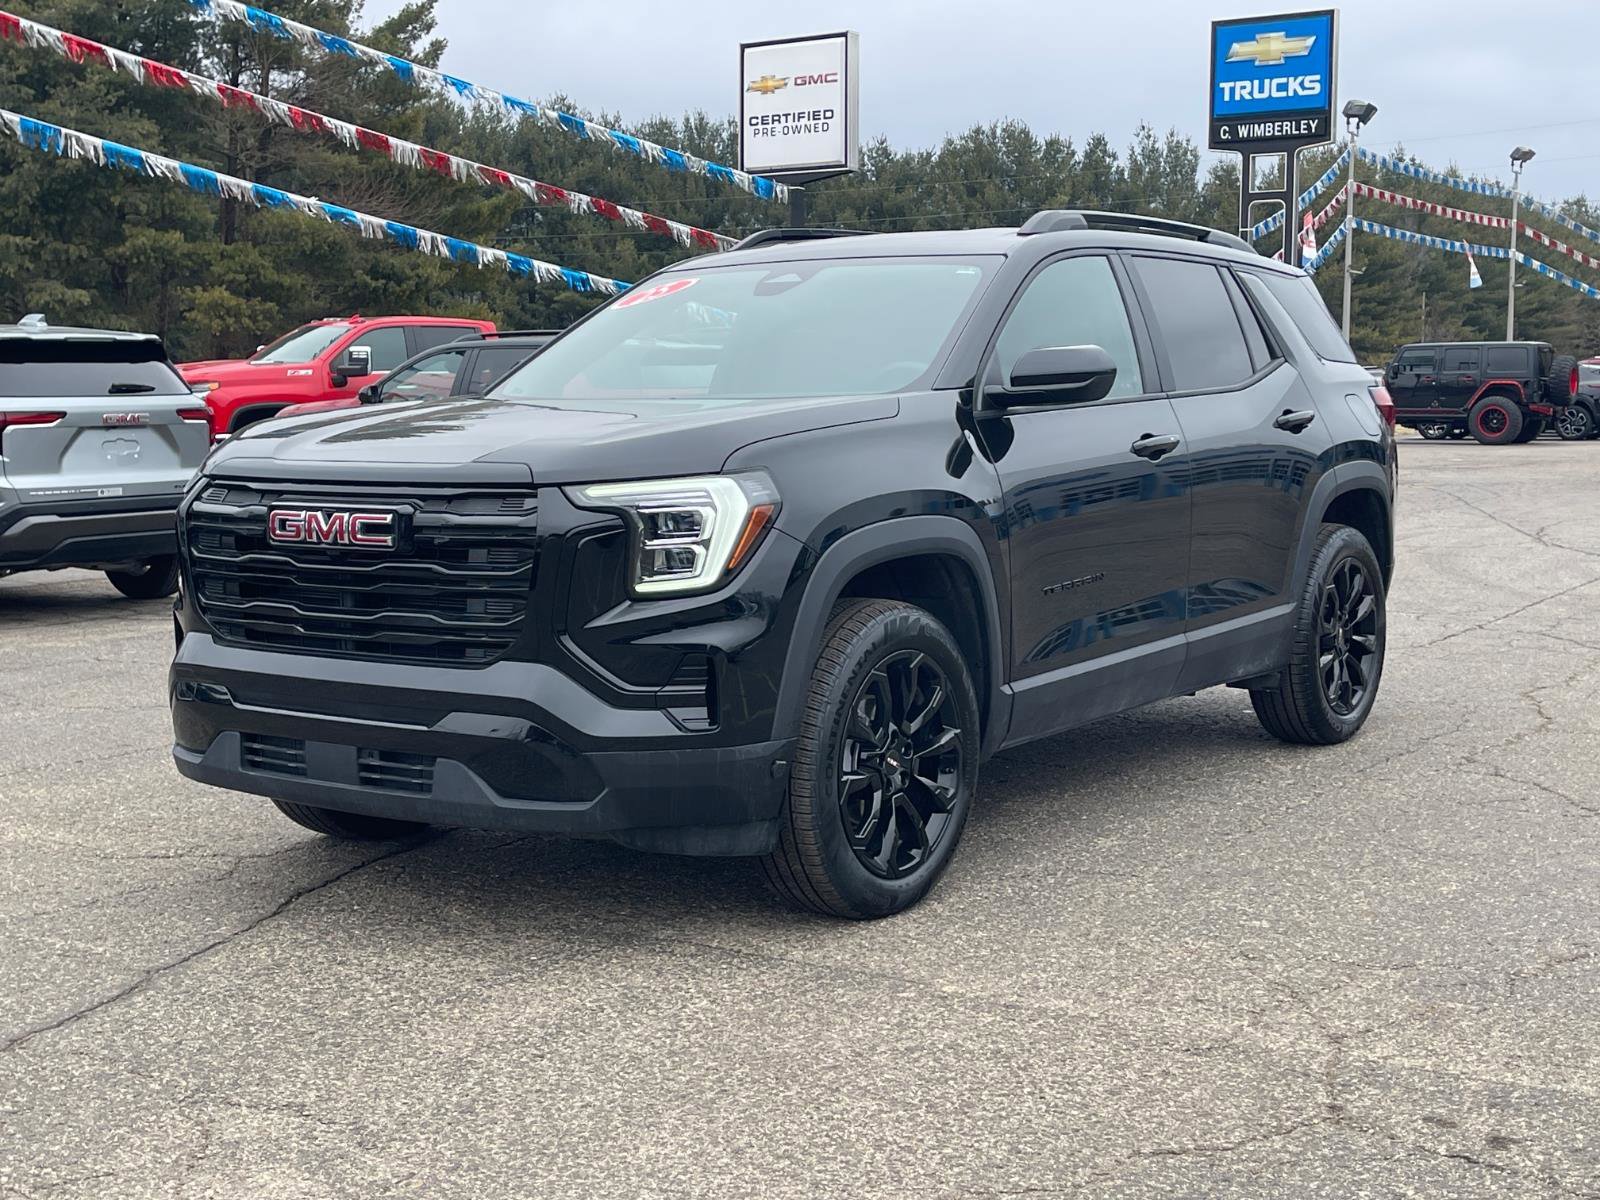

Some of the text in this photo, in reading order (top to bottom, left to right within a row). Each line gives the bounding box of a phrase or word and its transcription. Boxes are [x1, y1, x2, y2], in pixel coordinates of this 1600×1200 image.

[794, 72, 838, 86] GMC
[1219, 74, 1321, 102] TRUCKS
[749, 109, 834, 126] CERTIFIED
[753, 122, 830, 138] PRE-OWNED
[1220, 119, 1318, 140] C. WIMBERLEY
[268, 509, 394, 546] GMC
